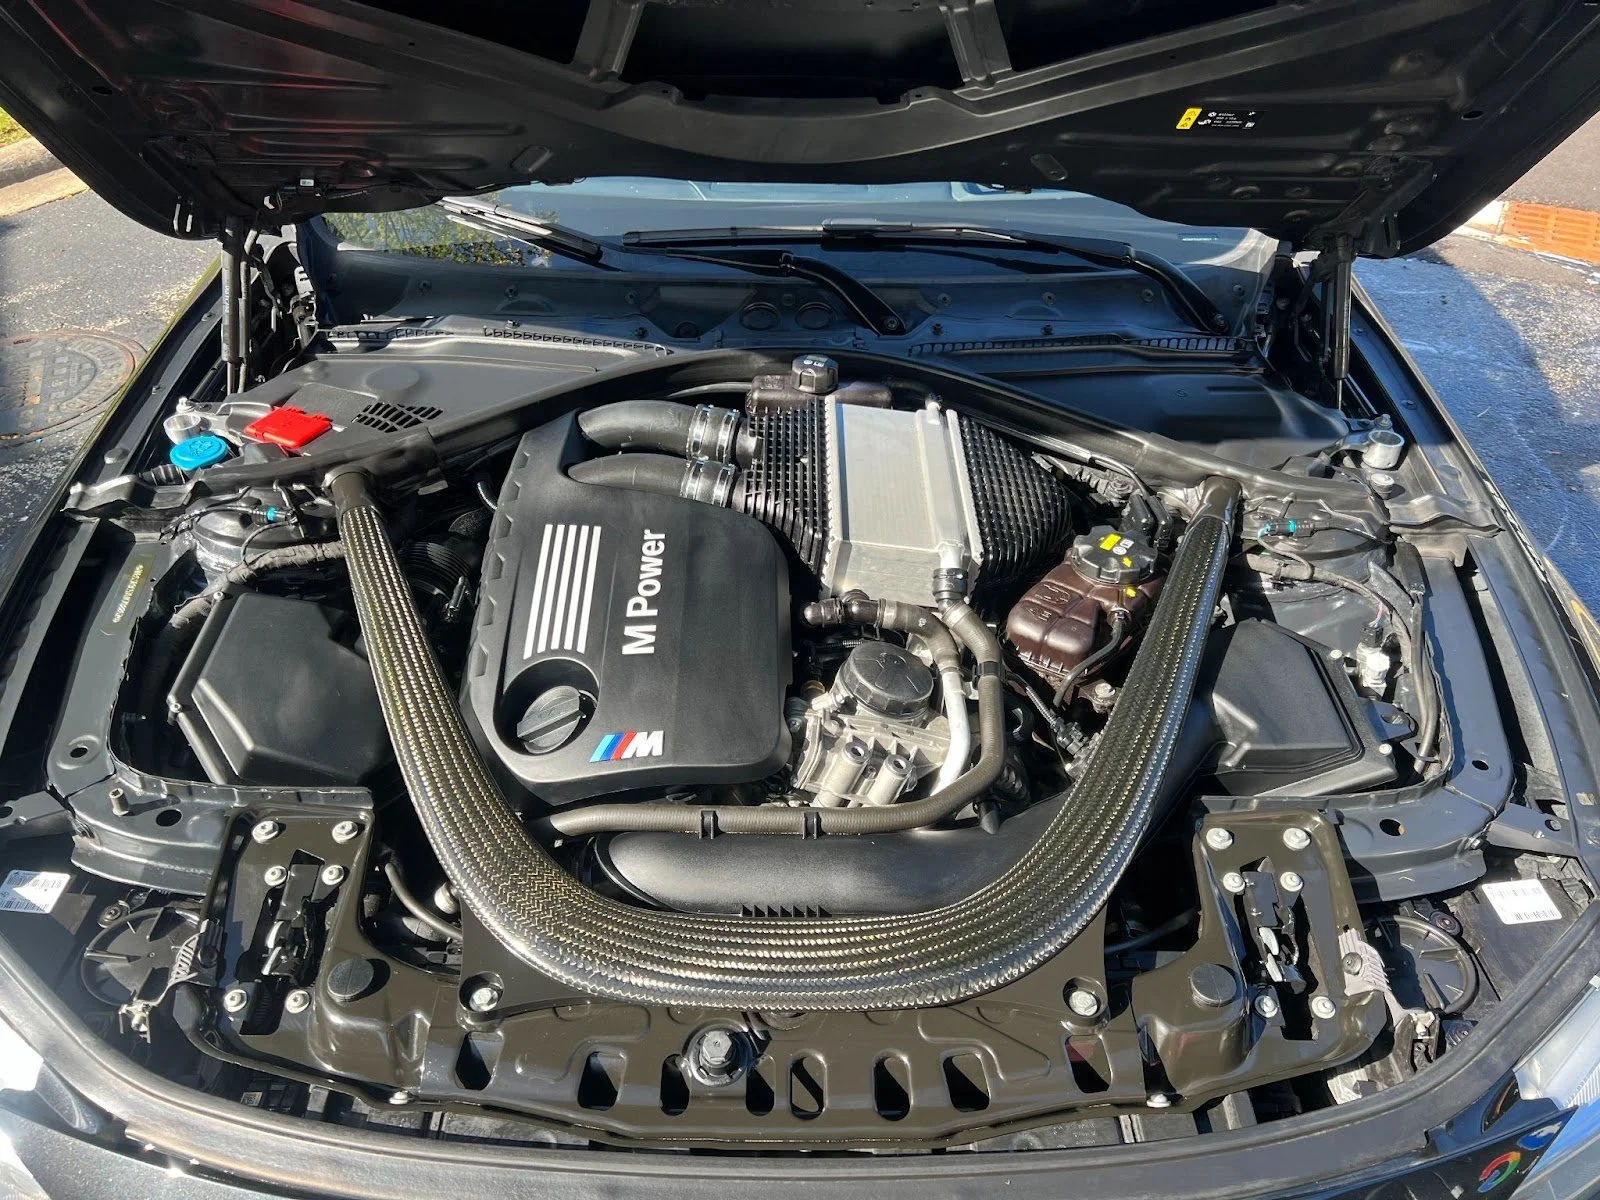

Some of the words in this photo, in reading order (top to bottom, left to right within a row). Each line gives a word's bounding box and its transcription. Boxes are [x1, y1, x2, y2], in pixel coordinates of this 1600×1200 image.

[626, 529, 666, 617] Power
[621, 624, 657, 655] M
[621, 730, 664, 759] M
